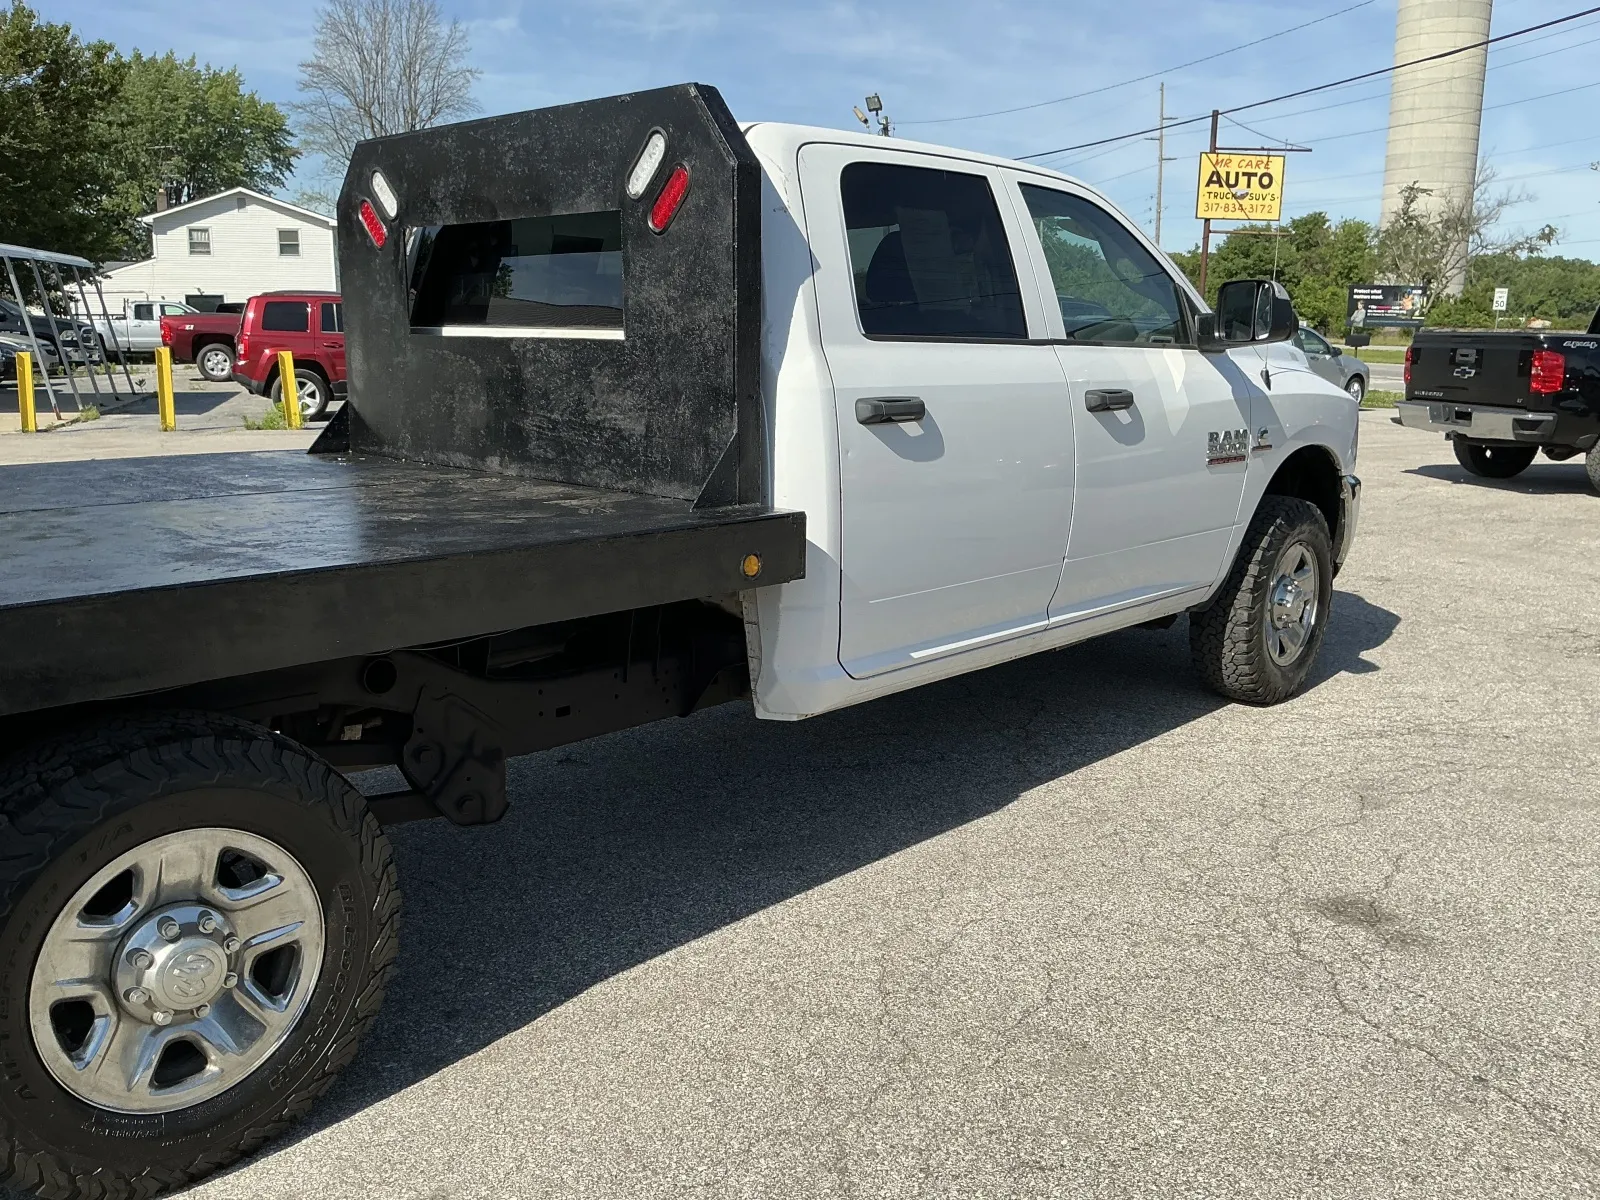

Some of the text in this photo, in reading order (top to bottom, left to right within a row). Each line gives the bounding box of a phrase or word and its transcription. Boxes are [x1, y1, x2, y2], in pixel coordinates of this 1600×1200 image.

[1237, 159, 1272, 169] CARE
[1204, 170, 1274, 190] AUTO
[1248, 193, 1276, 202] SUV'S
[1208, 429, 1248, 443] RAM
